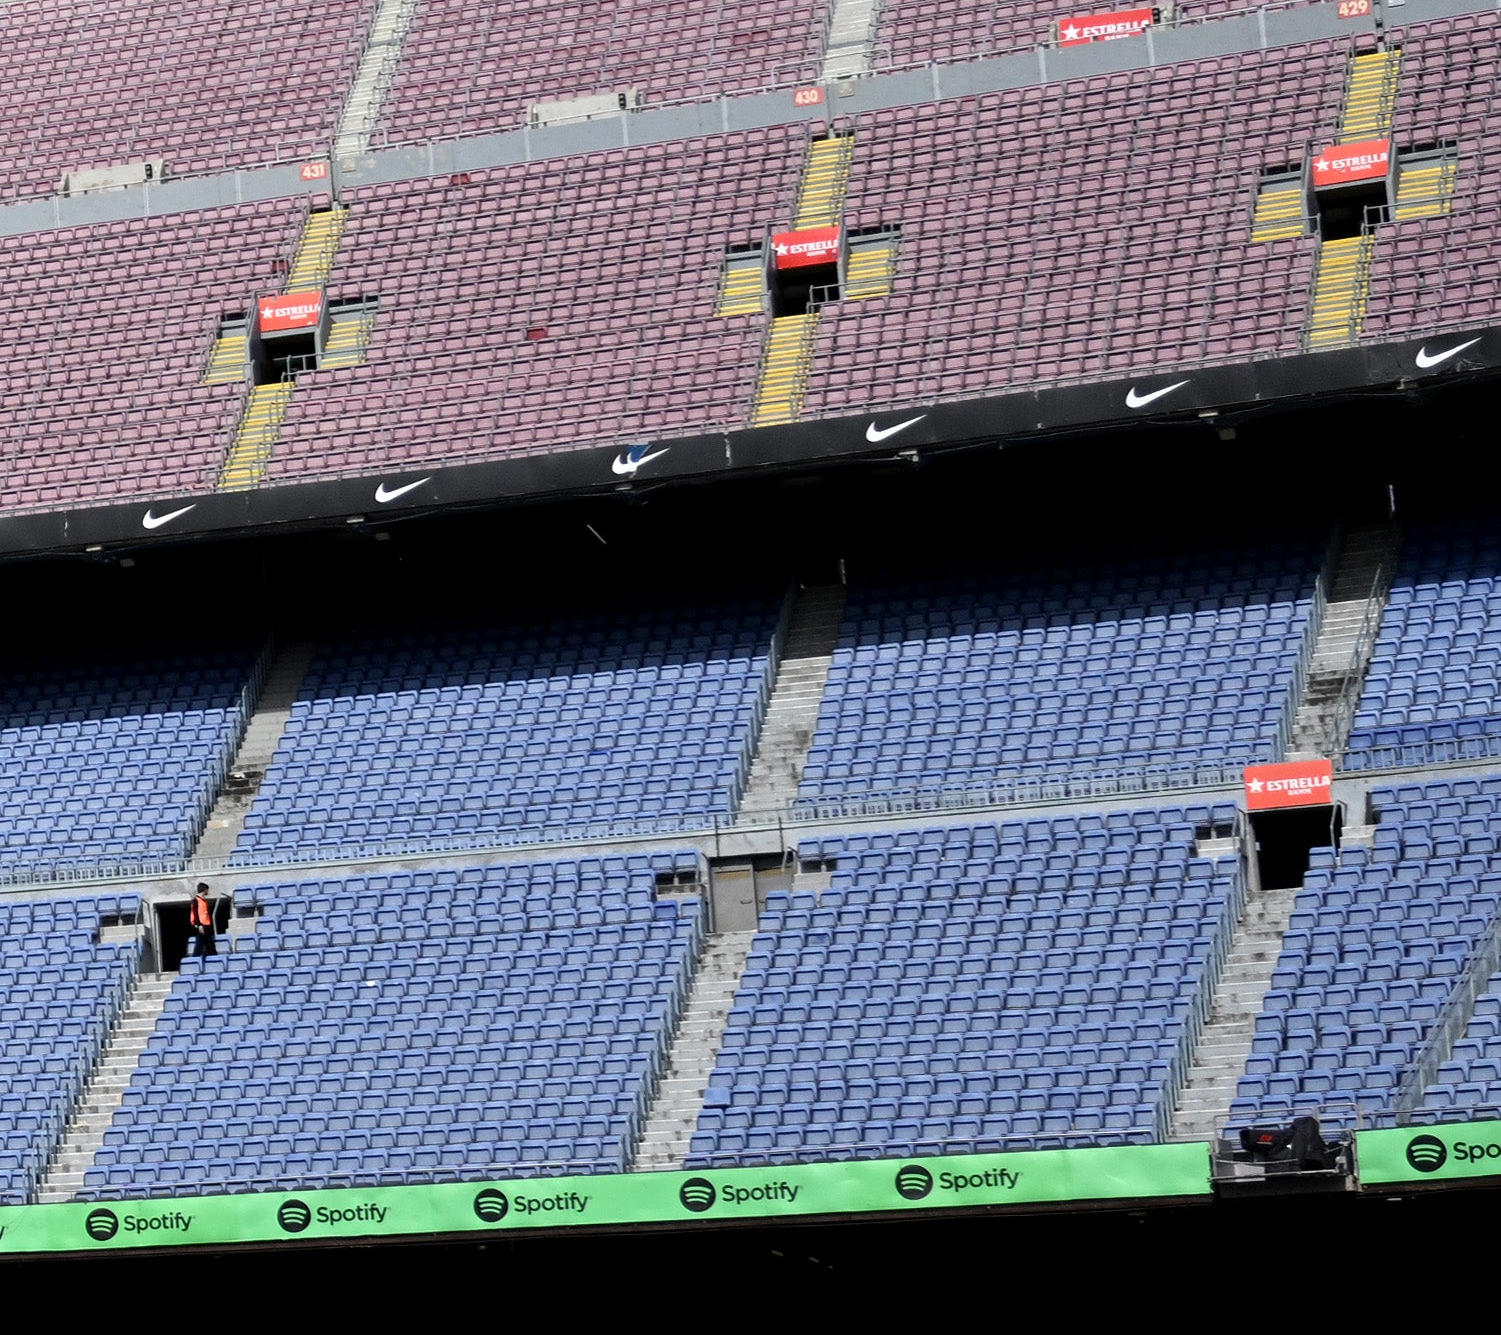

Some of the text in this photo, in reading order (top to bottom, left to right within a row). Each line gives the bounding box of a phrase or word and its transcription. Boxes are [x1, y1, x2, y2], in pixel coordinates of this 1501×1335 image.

[1338, 0, 1370, 19] 429
[795, 89, 818, 104] 430
[302, 164, 325, 178] 431
[1331, 152, 1389, 170] ESTRELLA
[1266, 775, 1332, 794] ESTRELLA
[940, 1168, 1019, 1191] Spotify
[723, 1182, 799, 1203] Spotify
[317, 1203, 387, 1224] Spotify
[515, 1193, 588, 1214] Spotify
[124, 1212, 192, 1233] Spotify
